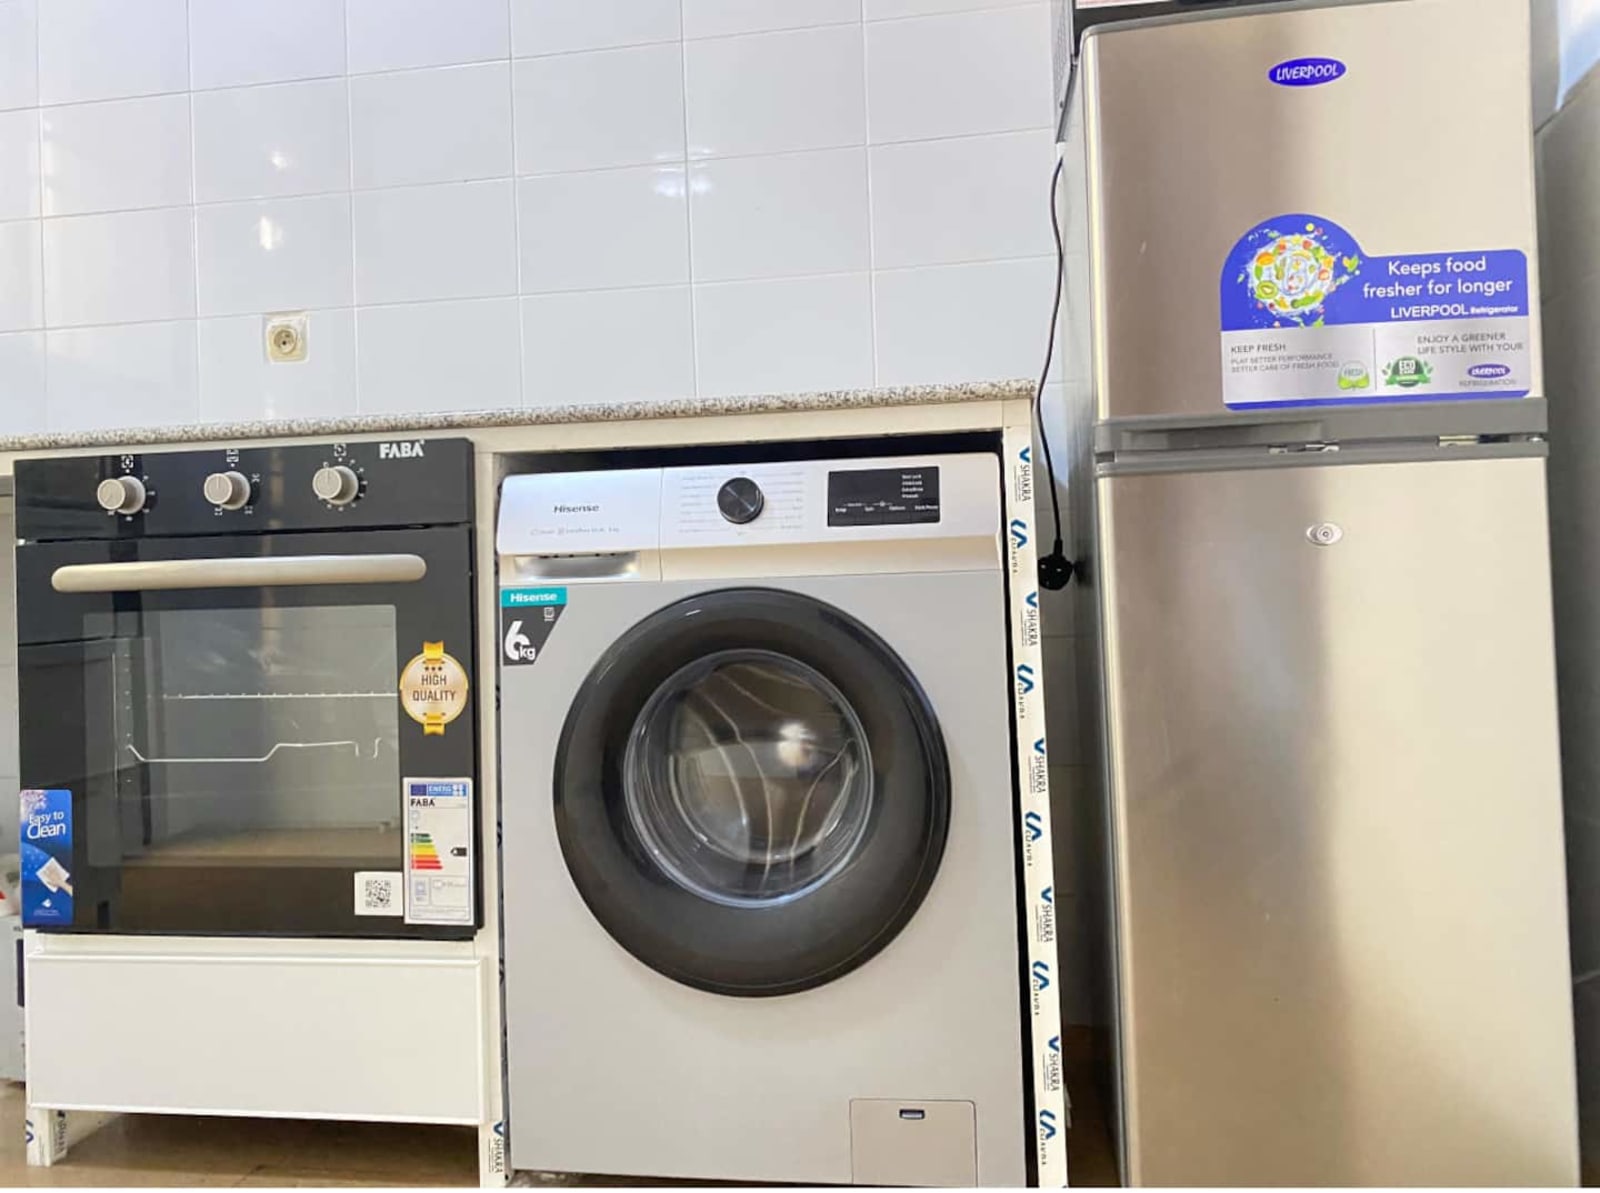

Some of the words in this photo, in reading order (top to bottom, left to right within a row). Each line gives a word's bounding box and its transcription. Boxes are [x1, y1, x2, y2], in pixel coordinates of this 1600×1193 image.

[1276, 62, 1339, 81] LIVERPOOL
[1388, 260, 1441, 278] Keeps
[1445, 255, 1486, 273] food
[1363, 281, 1422, 298] fresher
[1427, 279, 1453, 295] for
[1458, 278, 1513, 296] longer
[1390, 303, 1469, 318] LIVERPOOL
[1417, 335, 1449, 344] ENJOY
[1451, 334, 1459, 343] A
[1460, 332, 1506, 342] GREENER
[1230, 344, 1255, 353] KEEP
[1257, 342, 1286, 352] FRESH
[1417, 345, 1436, 354] LIFE
[1439, 344, 1466, 353] STYLE
[1468, 343, 1494, 352] WITH
[379, 441, 424, 459] FABA
[1020, 464, 1032, 501] SHAKRA
[553, 505, 600, 513] Hisense
[510, 593, 558, 603] Hisense
[1026, 609, 1038, 647] SHAKRA
[421, 674, 447, 686] HIGH
[412, 690, 456, 702] QUALITY
[1034, 755, 1046, 794] SHAKRA
[410, 798, 436, 807] FABA
[29, 812, 52, 825] Easy
[53, 811, 64, 821] to
[27, 819, 66, 839] Clean
[1041, 904, 1053, 943] SHAKRA
[1048, 1053, 1060, 1092] SHAKRA
